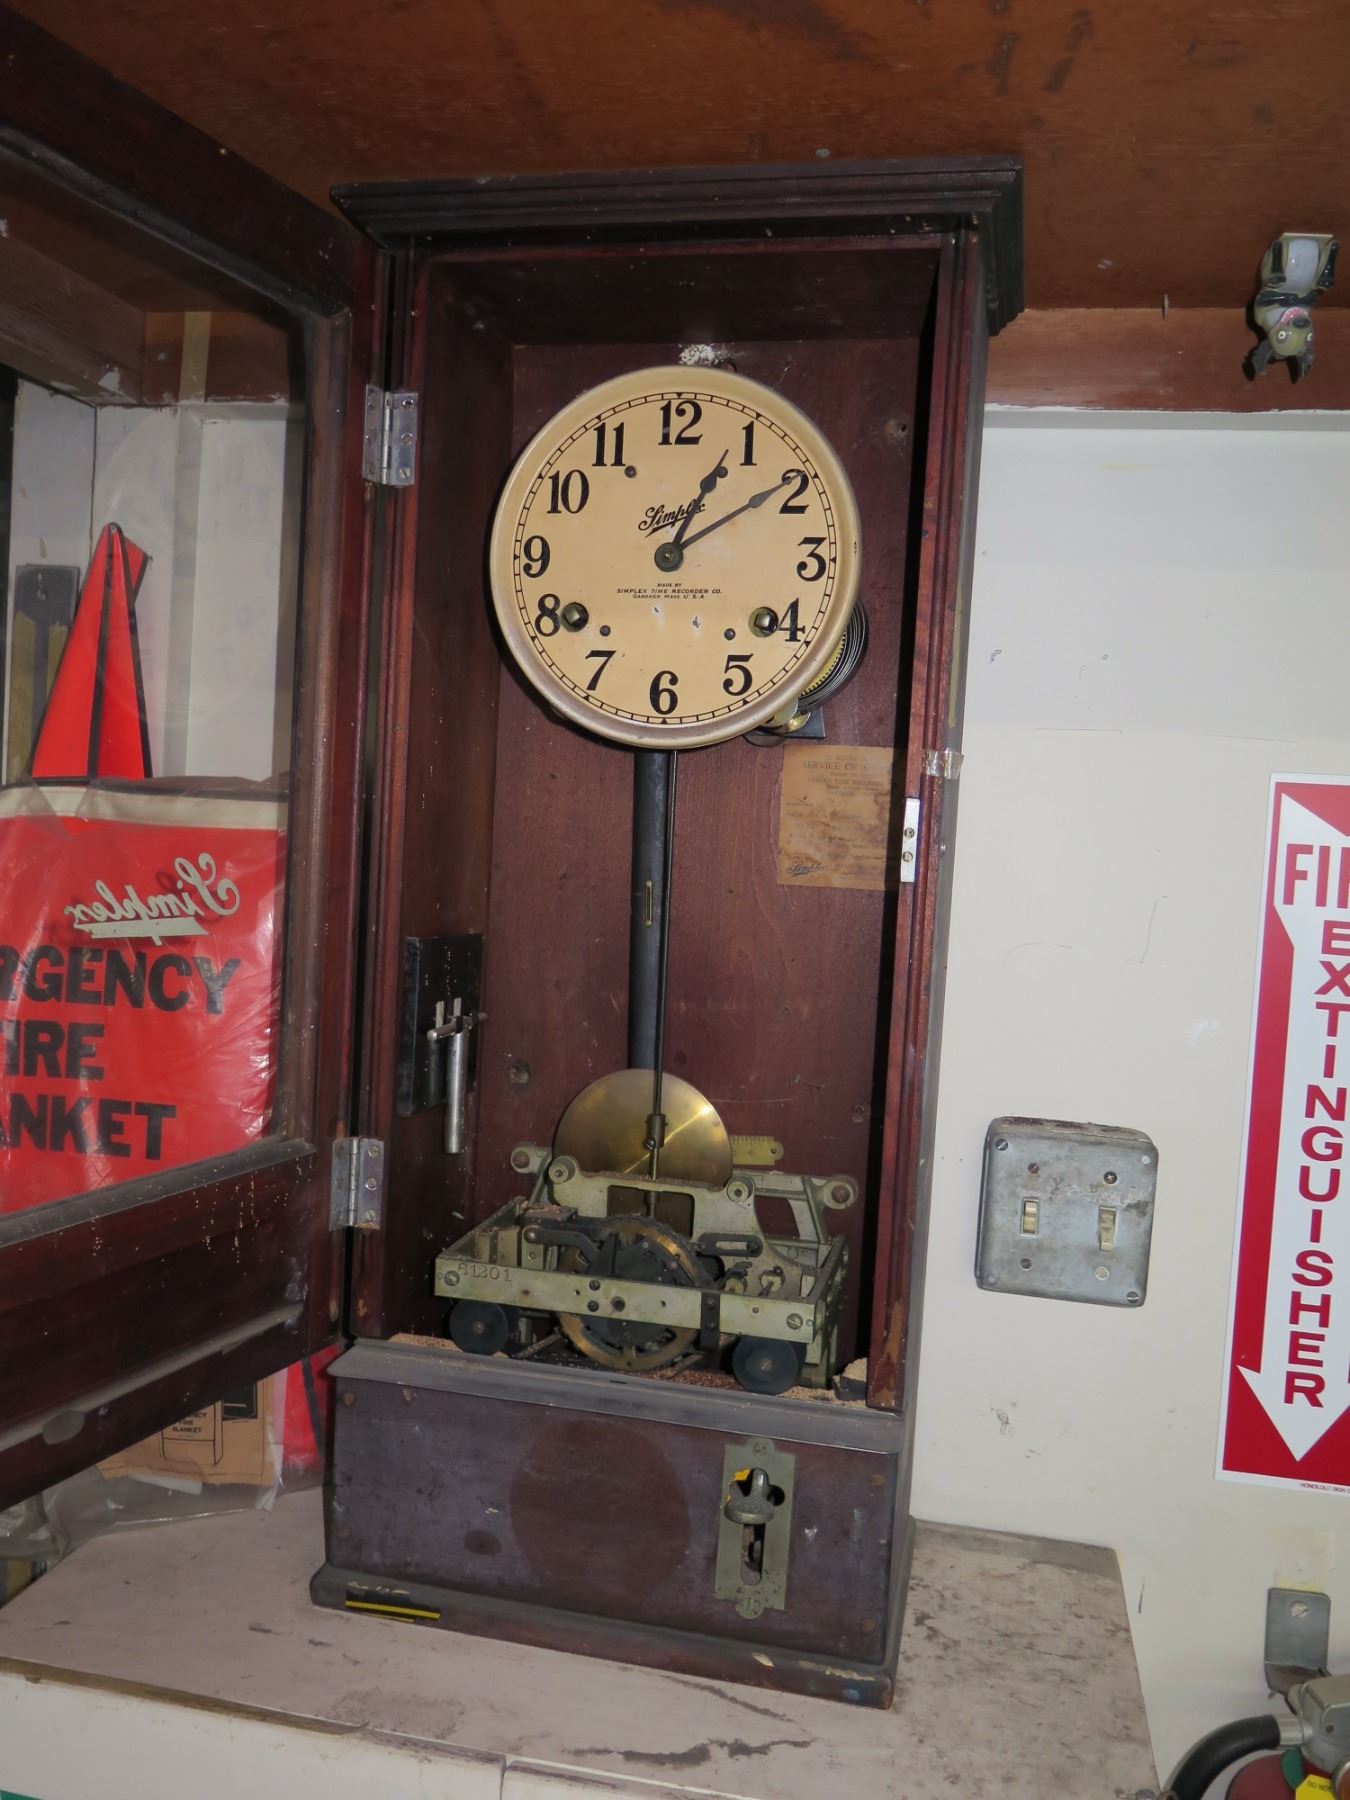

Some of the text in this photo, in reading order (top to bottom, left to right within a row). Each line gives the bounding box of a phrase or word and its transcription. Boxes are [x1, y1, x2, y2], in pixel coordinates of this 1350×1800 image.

[592, 422, 626, 467] 11
[658, 400, 703, 446] 12
[739, 420, 757, 466] 1
[547, 469, 590, 514] 10
[779, 468, 809, 515] 2
[522, 535, 551, 579] 9
[796, 536, 827, 582] 3
[534, 593, 561, 637] 8
[777, 598, 806, 643] 4
[585, 650, 617, 691] 7
[649, 670, 679, 715] 6
[723, 653, 754, 696] 5
[0, 1019, 105, 1080] IRE
[0, 1093, 177, 1160] NKET
